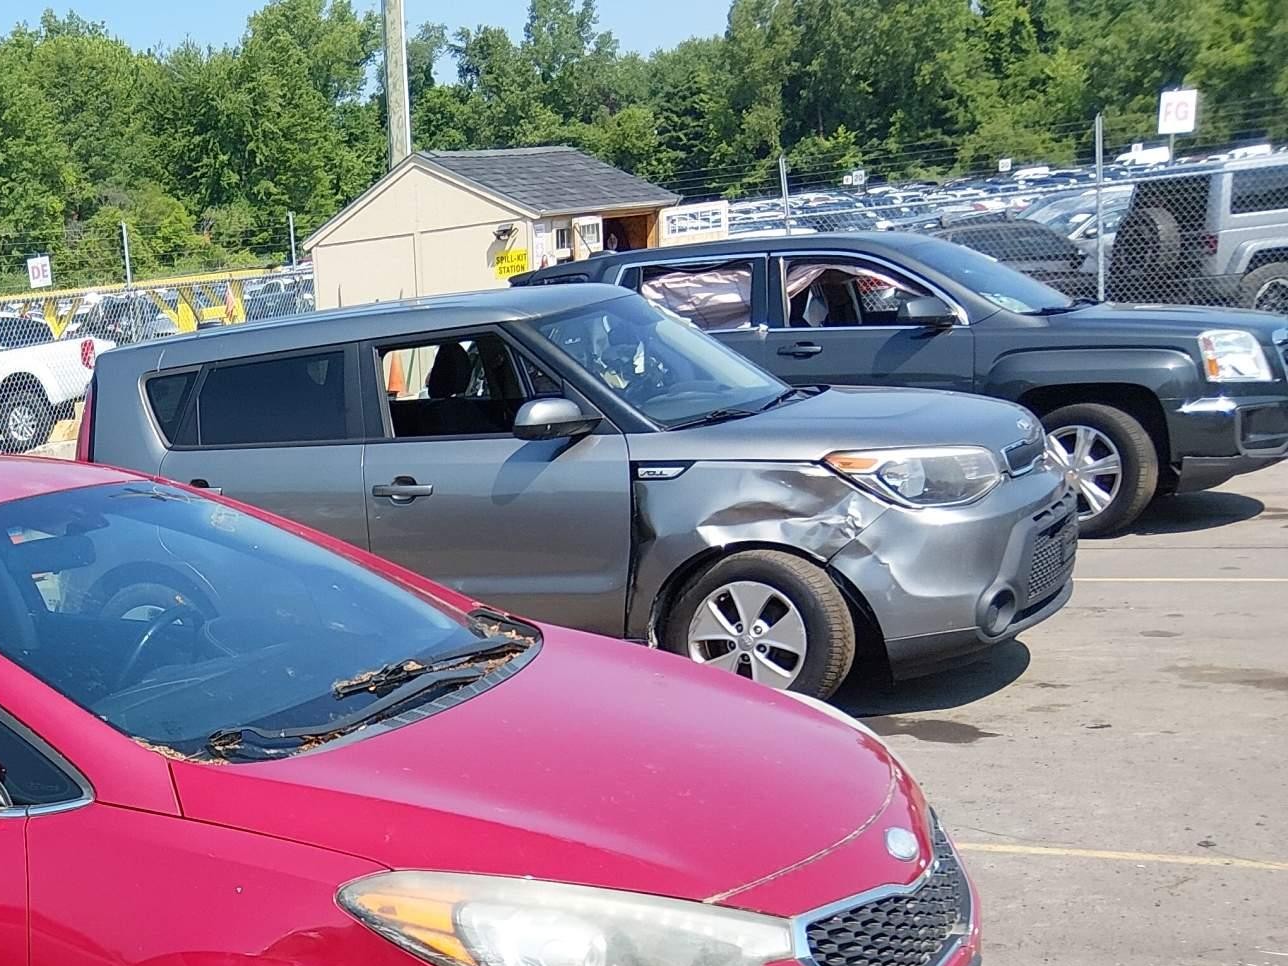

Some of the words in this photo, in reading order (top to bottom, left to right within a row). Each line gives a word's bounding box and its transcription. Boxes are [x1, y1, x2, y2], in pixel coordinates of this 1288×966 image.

[1163, 101, 1190, 122] FG
[495, 253, 527, 265] SPILL-KIT
[30, 263, 49, 281] DE
[498, 264, 525, 275] STATION
